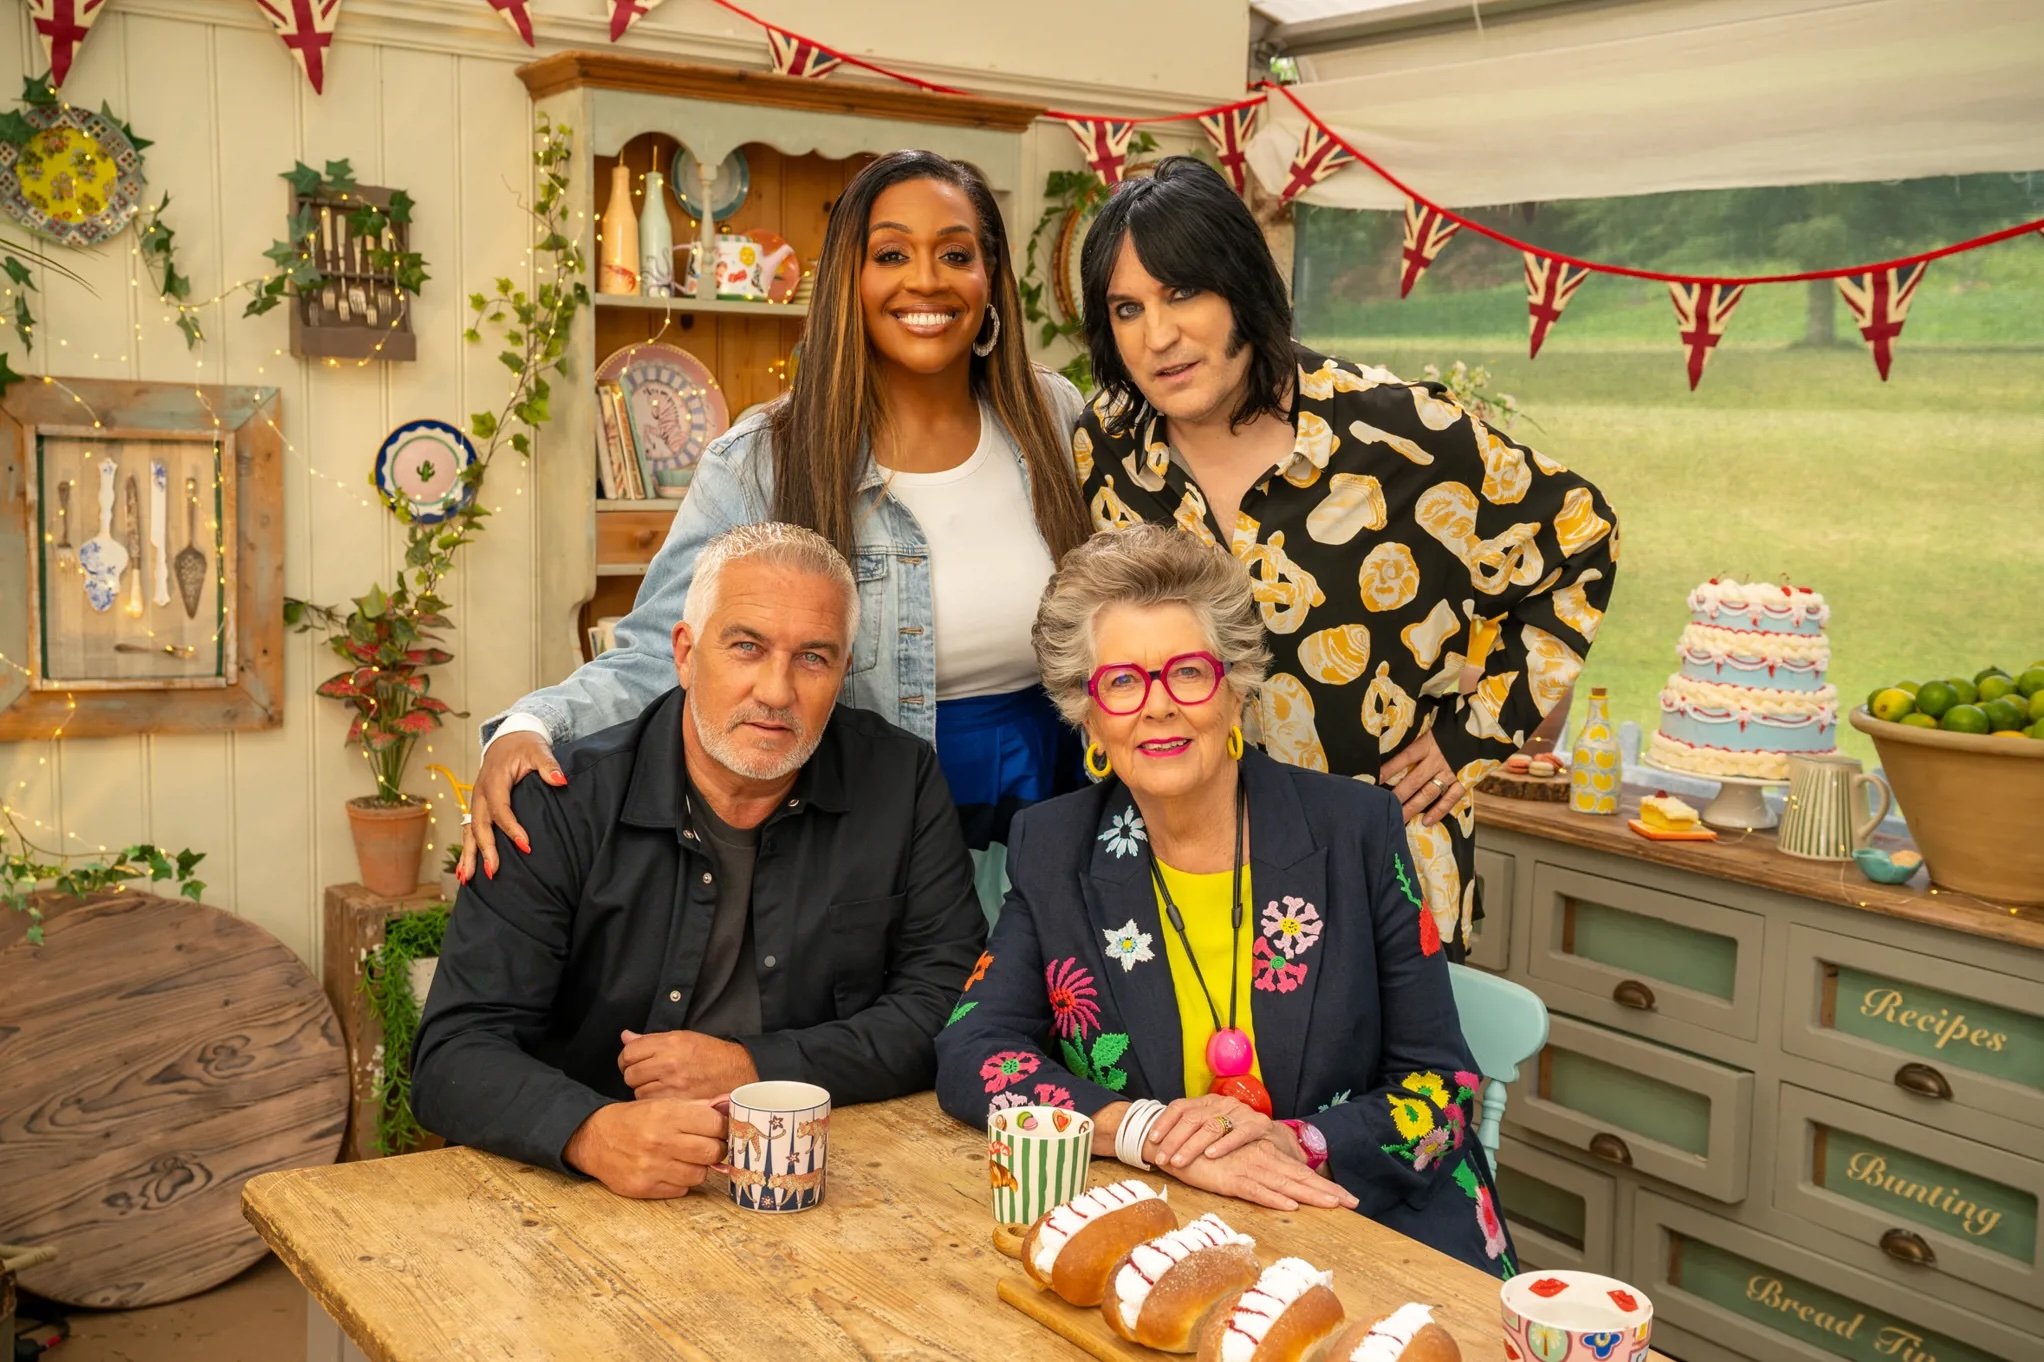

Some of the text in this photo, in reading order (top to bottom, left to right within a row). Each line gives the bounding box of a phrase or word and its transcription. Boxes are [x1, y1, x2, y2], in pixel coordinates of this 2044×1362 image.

[1860, 988, 2008, 1052] Recipes
[1846, 1152, 2002, 1236] Bunting
[1746, 1275, 1866, 1340] Bread
